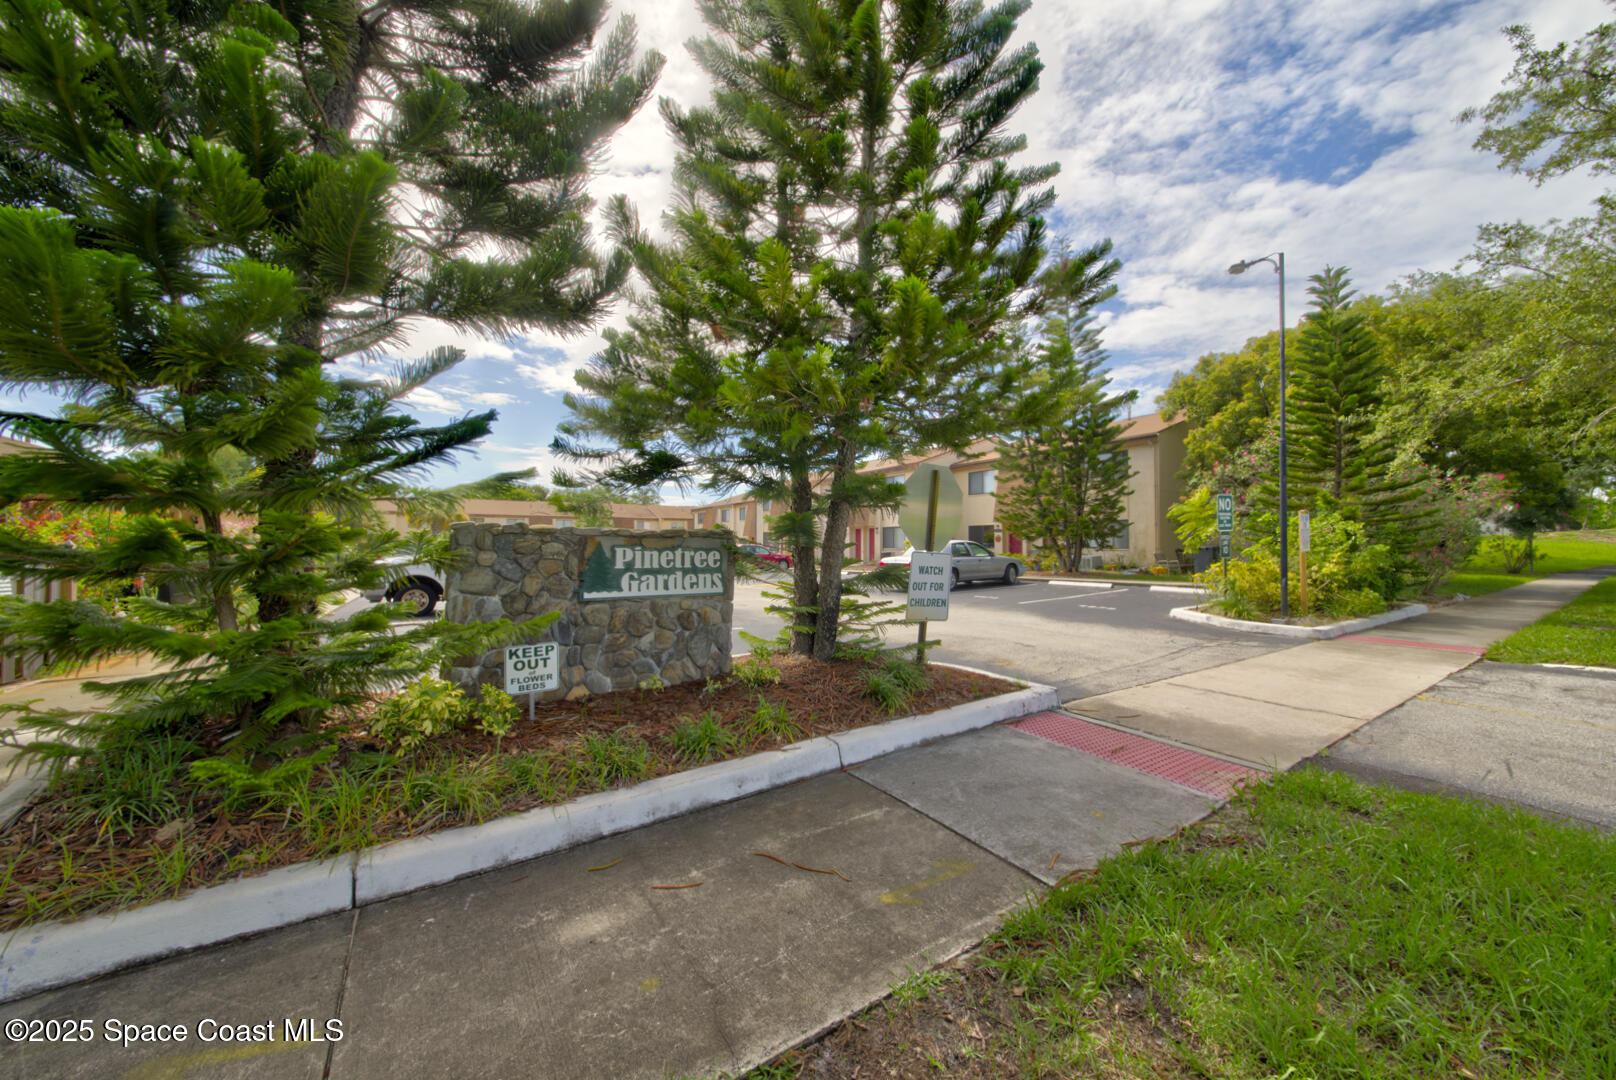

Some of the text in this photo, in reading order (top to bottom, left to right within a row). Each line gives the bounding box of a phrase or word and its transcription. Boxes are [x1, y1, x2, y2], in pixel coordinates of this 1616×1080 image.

[1219, 498, 1231, 511] NO
[614, 546, 721, 569] Pinetree
[918, 565, 944, 575] WATCH
[621, 571, 723, 593] Gardens
[912, 581, 944, 592] OUT FOR
[910, 598, 947, 608] CHILDREN
[508, 645, 555, 660] KEEP
[513, 657, 551, 671] OUT
[510, 674, 553, 685] FLOWER
[518, 682, 546, 691] BEDS
